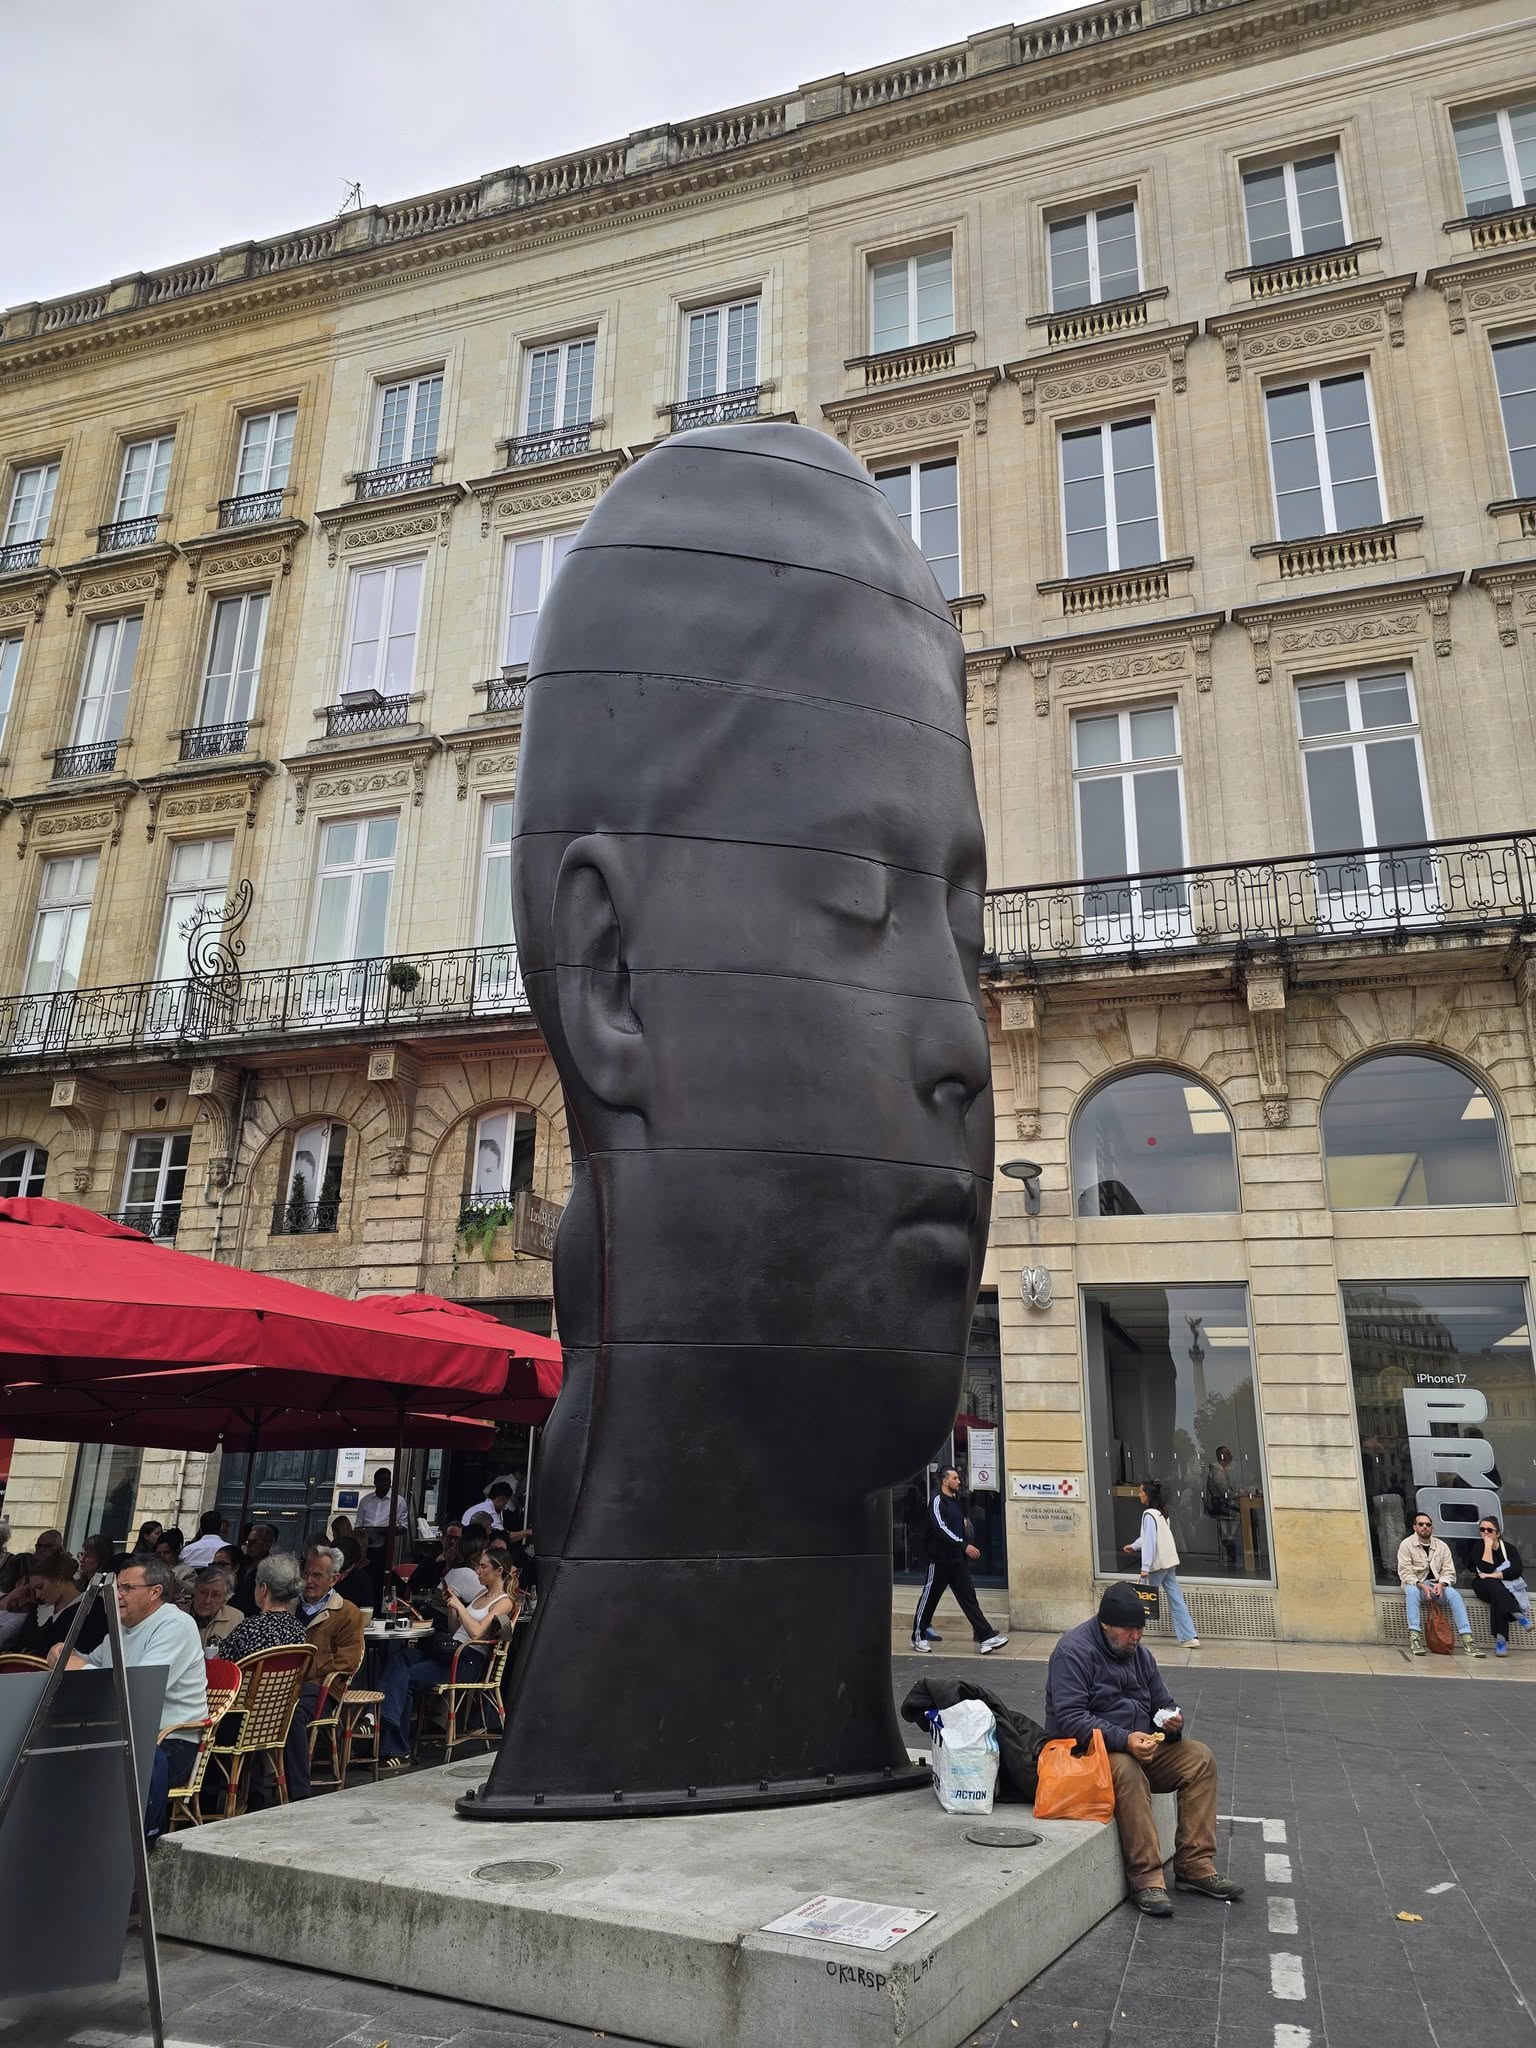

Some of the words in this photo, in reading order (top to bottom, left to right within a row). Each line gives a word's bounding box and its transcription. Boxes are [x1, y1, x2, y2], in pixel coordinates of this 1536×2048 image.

[541, 1210, 559, 1230] RÉG
[543, 1234, 554, 1251] Ca
[1417, 1374, 1454, 1384] iPhone
[1455, 1374, 1467, 1384] 17
[1403, 1388, 1503, 1539] PRO
[1134, 1590, 1158, 1601] nac
[955, 1790, 987, 1800] ACTION
